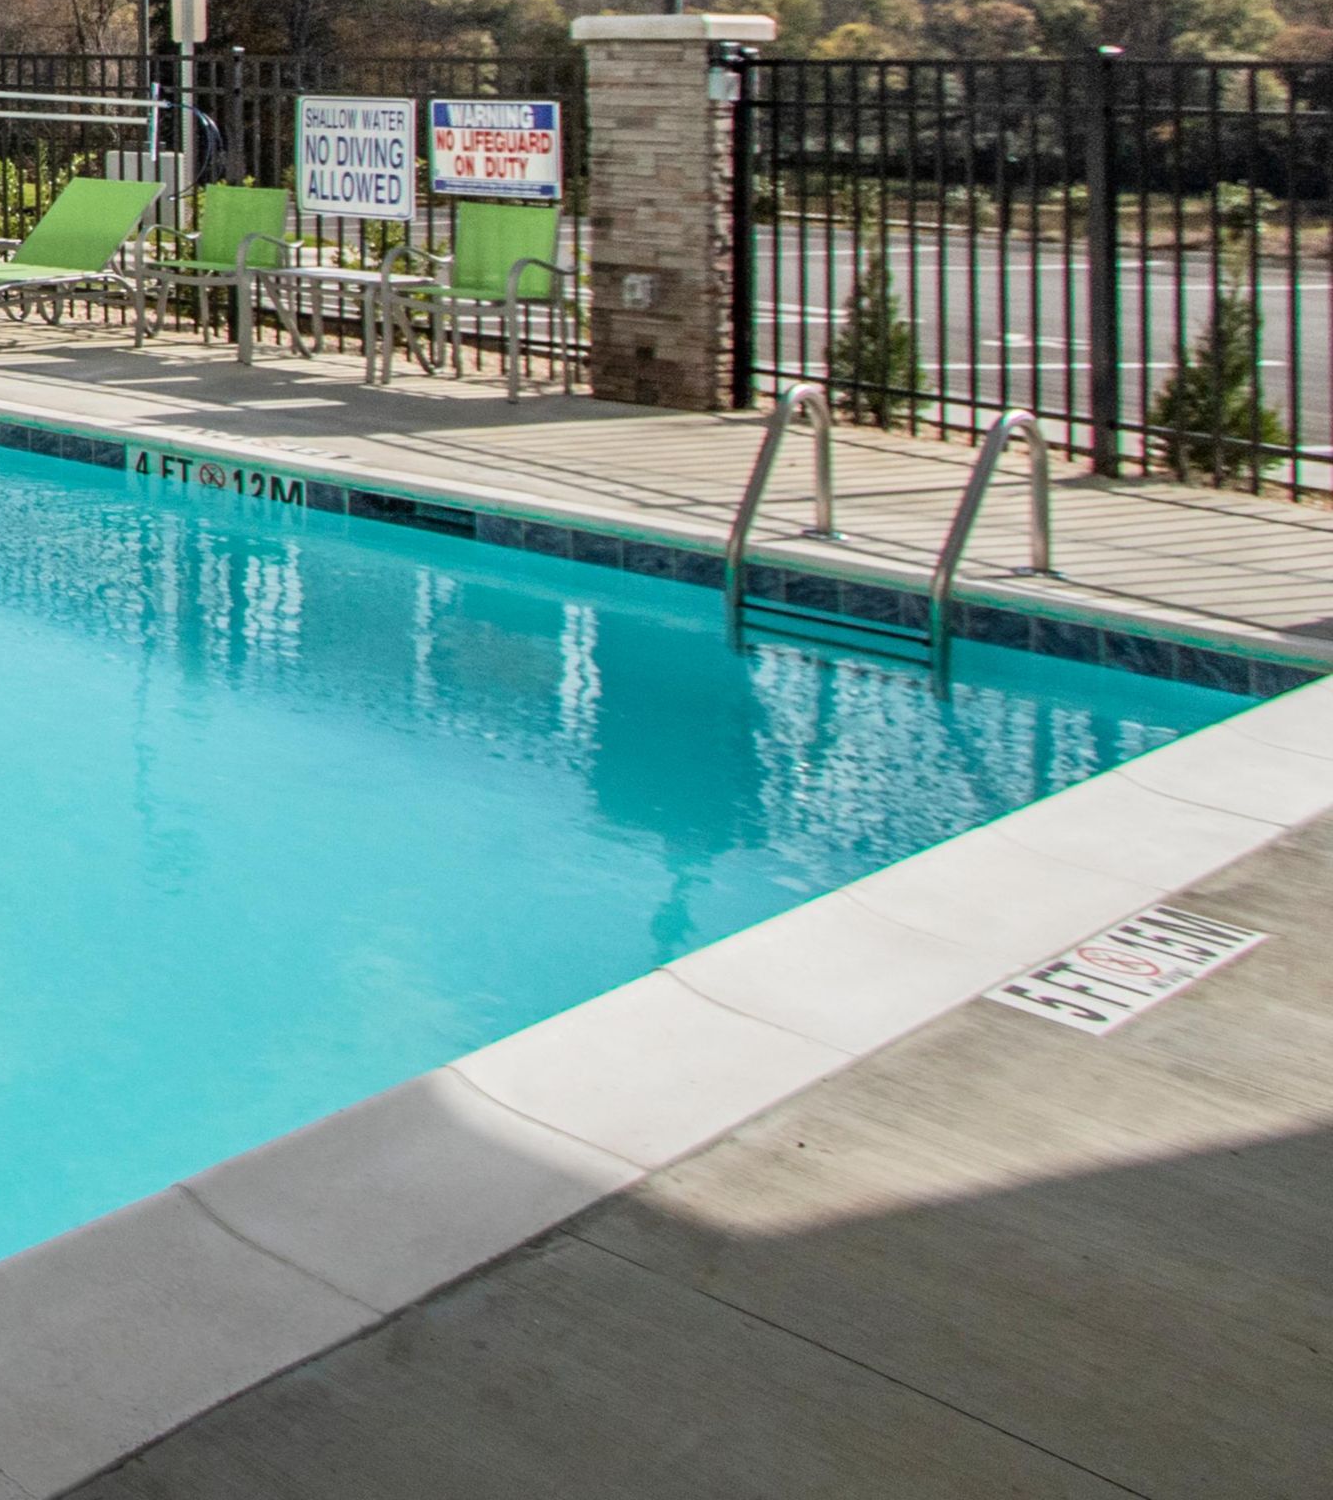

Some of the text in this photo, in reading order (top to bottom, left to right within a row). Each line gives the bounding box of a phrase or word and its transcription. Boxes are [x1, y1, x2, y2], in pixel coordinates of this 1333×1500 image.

[305, 107, 405, 132] SHALLOW WATER
[448, 103, 534, 128] WARNING
[306, 135, 404, 170] NO DIVING
[436, 130, 552, 154] NO LIFEGUARD
[454, 155, 529, 179] ON DUTY
[307, 170, 401, 204] ALLOWED
